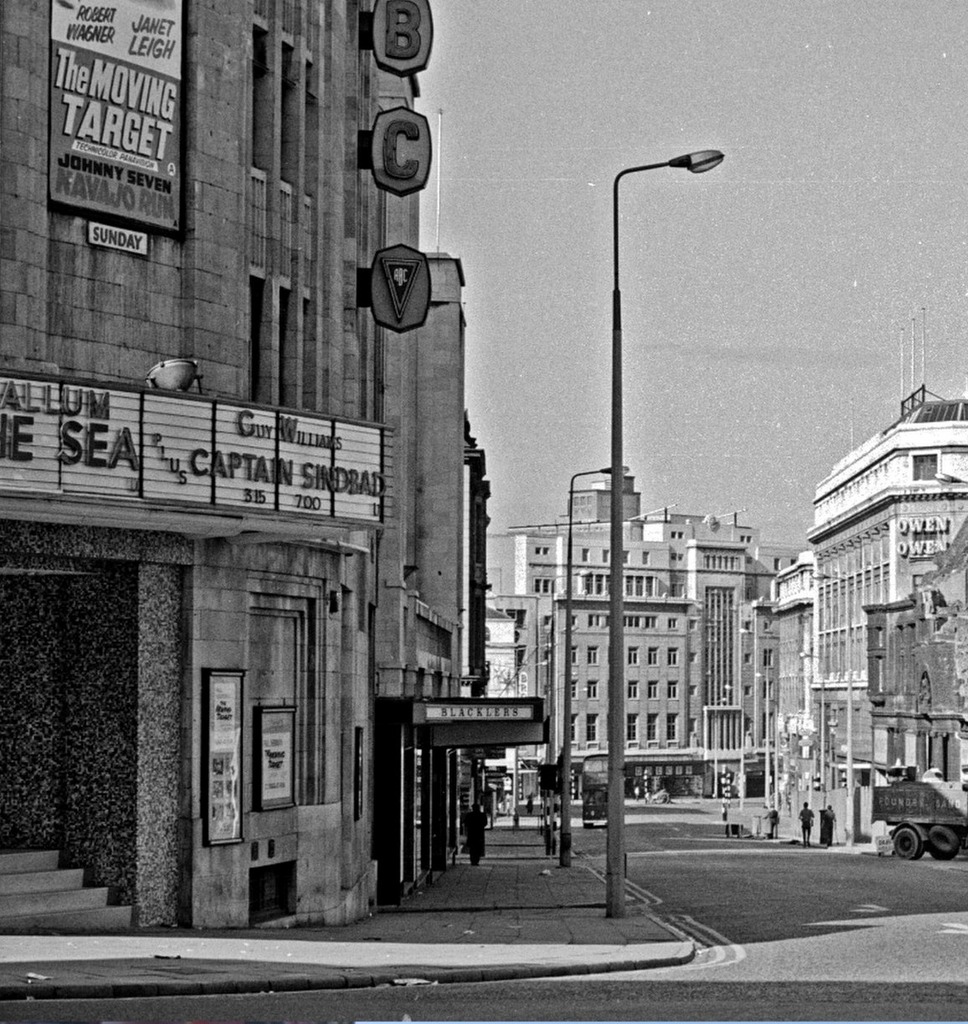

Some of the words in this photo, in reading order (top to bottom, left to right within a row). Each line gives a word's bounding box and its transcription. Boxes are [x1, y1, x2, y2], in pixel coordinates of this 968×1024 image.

[76, 5, 117, 23] ROBERT
[131, 14, 176, 37] JANET
[66, 23, 116, 44] WAGNER
[128, 35, 176, 59] LEIGH
[54, 47, 90, 95] The
[88, 58, 177, 122] MOVING
[61, 93, 174, 161] TARGET
[57, 153, 124, 180] JOHNNY
[126, 169, 172, 195] SEVEN
[92, 226, 143, 250] SUNDAY
[60, 420, 140, 471] SEA
[190, 448, 293, 486] CAPTAIN
[302, 462, 387, 498] SINDBAD
[294, 493, 322, 511] 700
[897, 515, 951, 535] OWEN
[897, 539, 951, 557] OWEN
[441, 707, 519, 717] BLACKLERS
